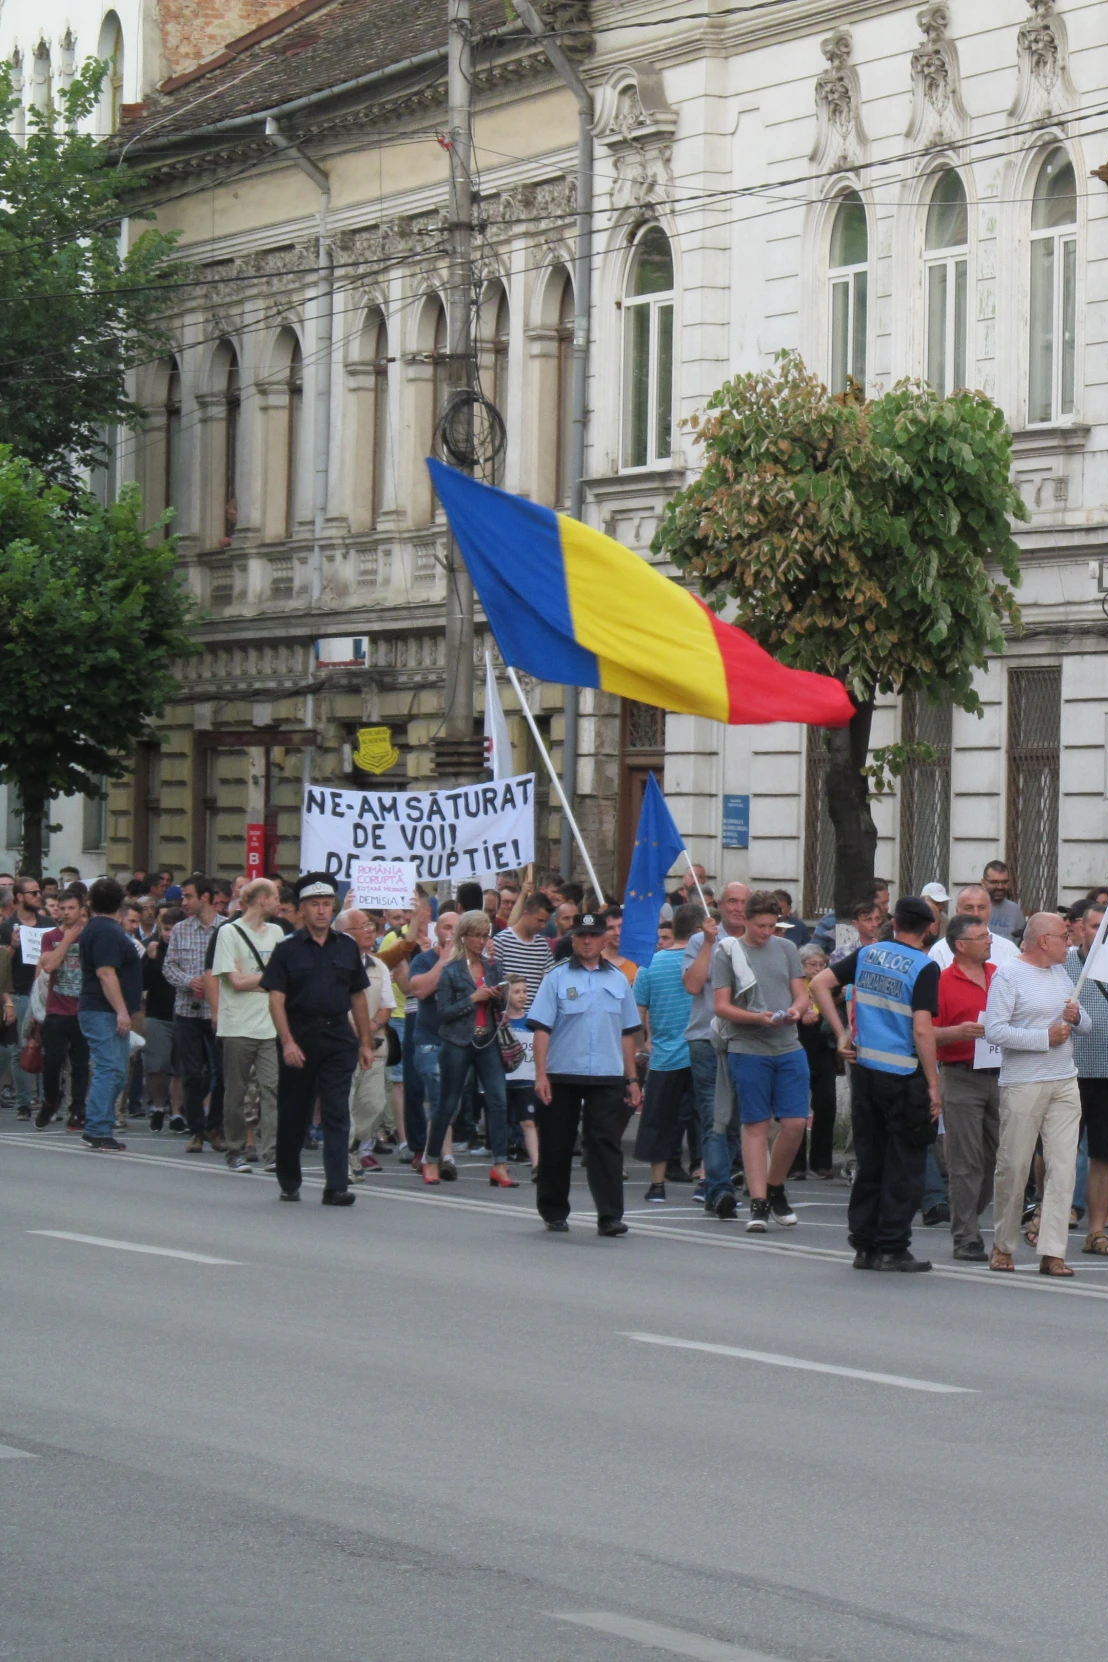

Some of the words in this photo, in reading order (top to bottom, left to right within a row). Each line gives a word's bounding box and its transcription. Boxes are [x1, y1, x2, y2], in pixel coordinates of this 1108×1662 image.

[306, 789, 400, 822] NE-AM
[406, 777, 534, 823] SĂTURAT
[353, 822, 387, 850] DE
[400, 823, 458, 851] VOI!
[867, 948, 913, 973] DIALOG
